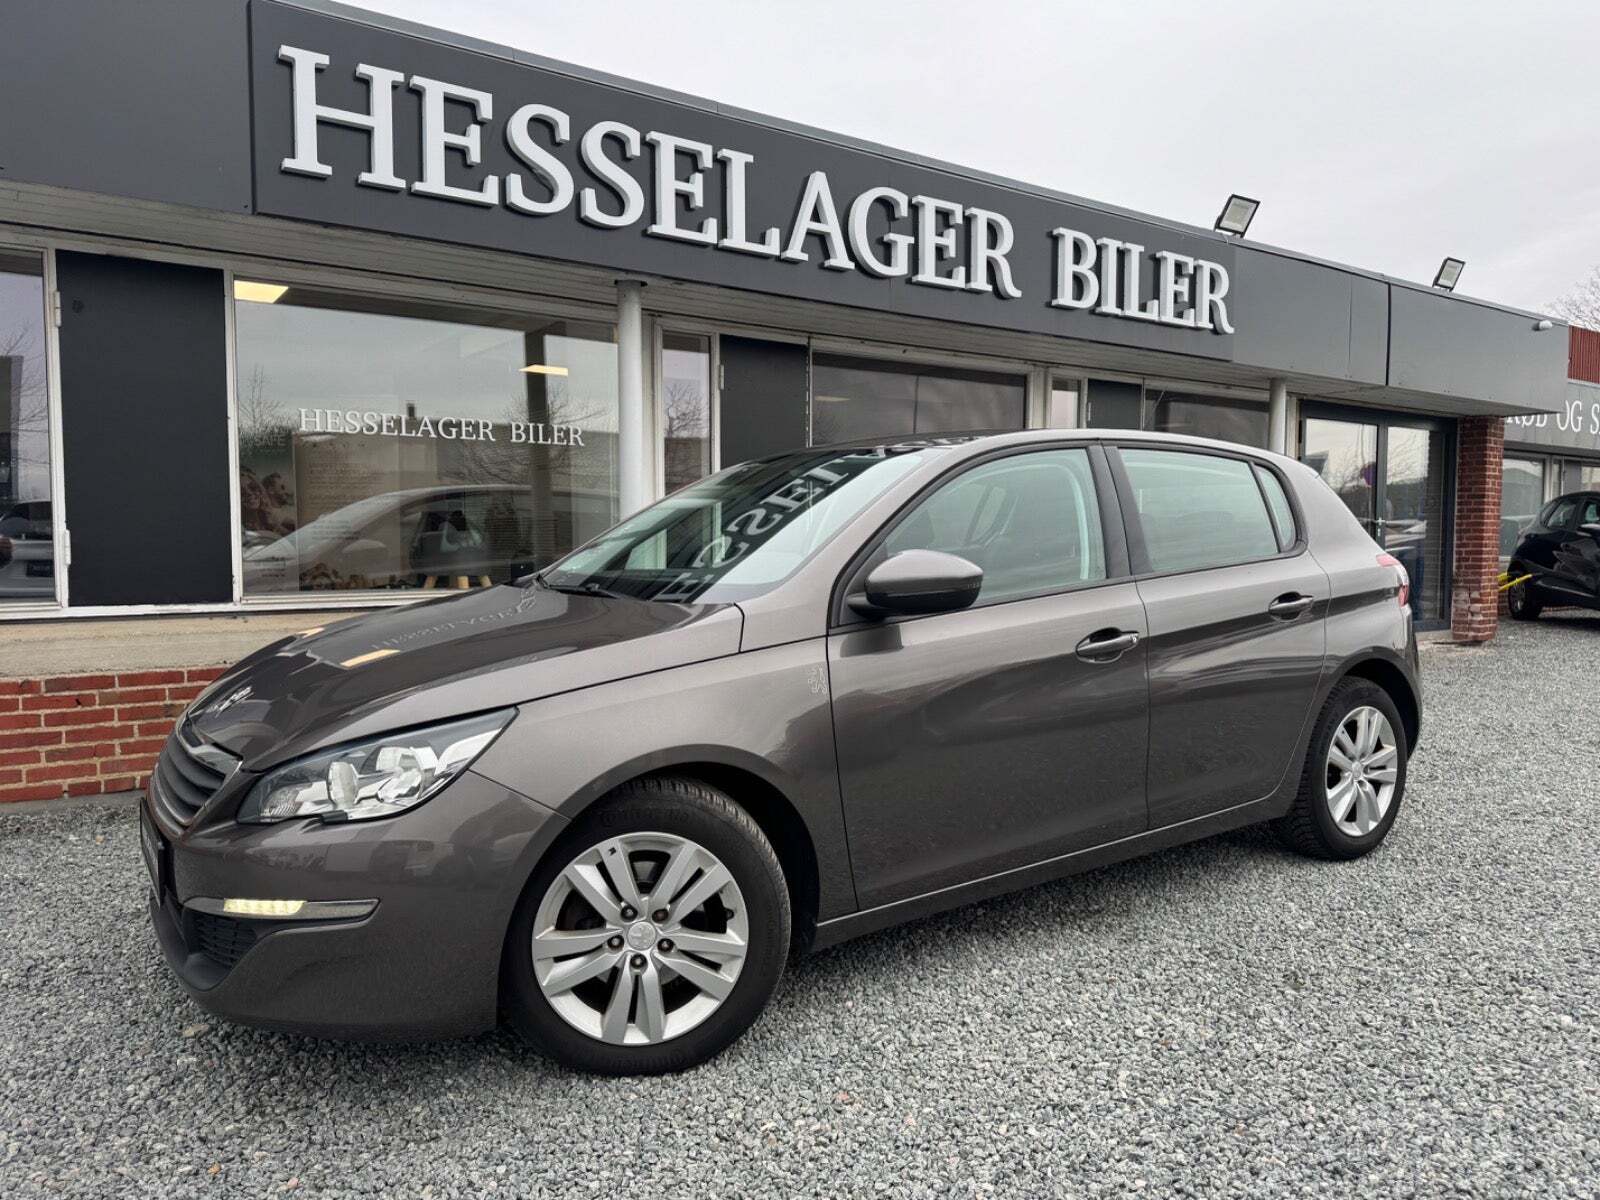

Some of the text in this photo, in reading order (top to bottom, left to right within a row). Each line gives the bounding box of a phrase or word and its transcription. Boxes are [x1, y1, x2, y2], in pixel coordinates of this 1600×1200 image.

[279, 45, 1235, 334] HESSELAGER BILER
[298, 407, 585, 447] HESSELAGER BILER
